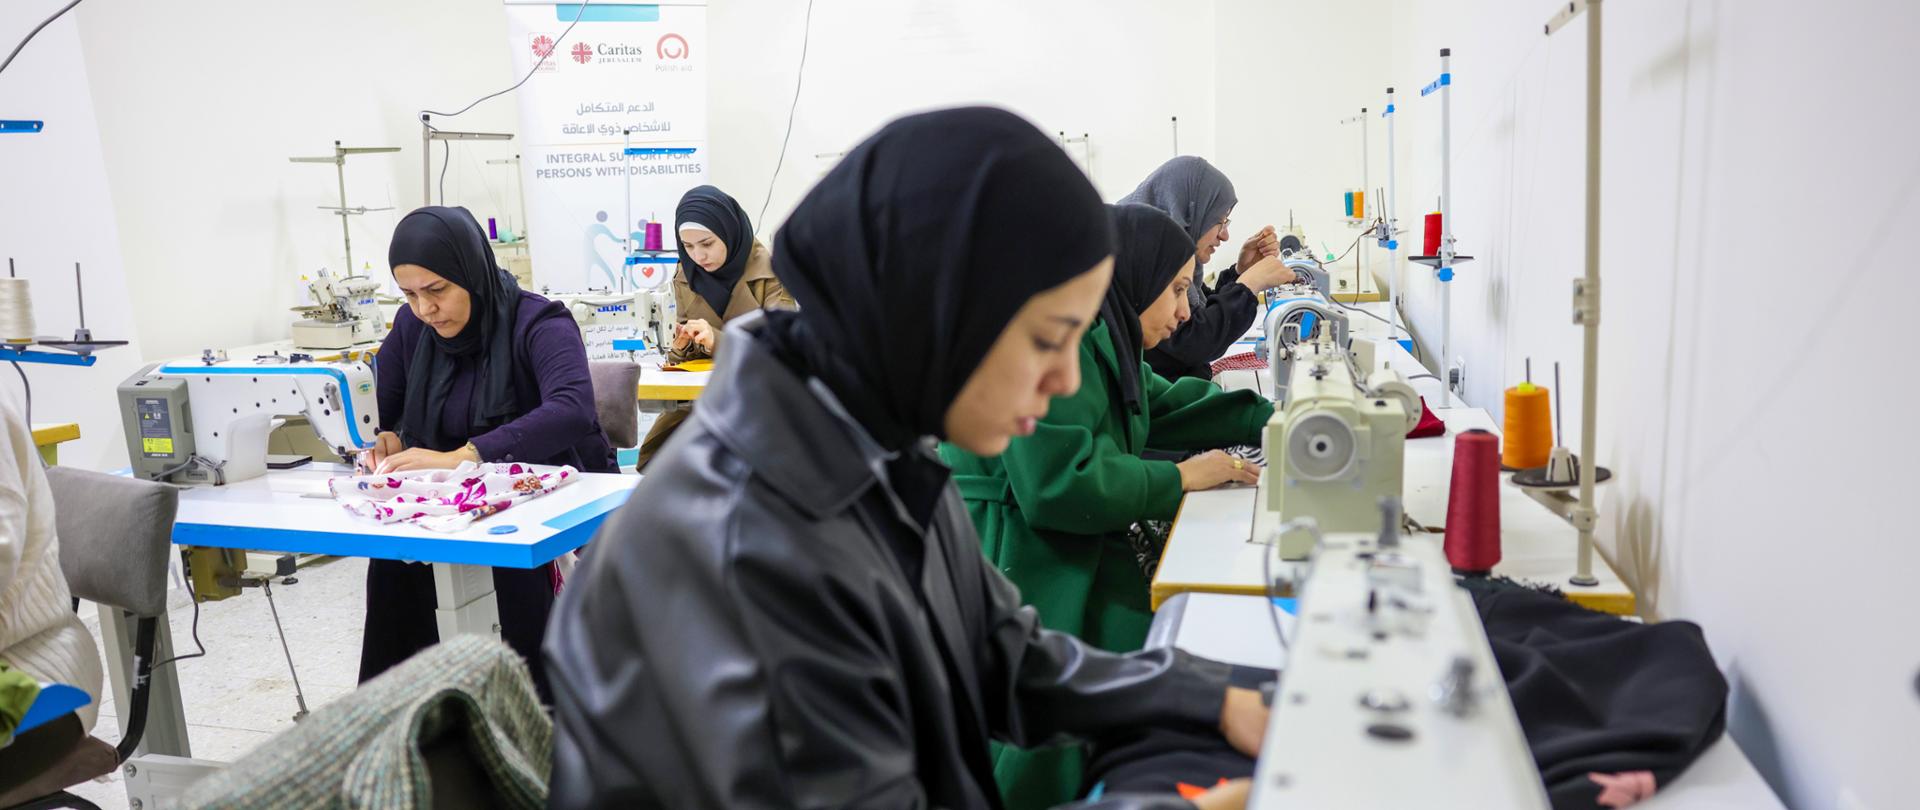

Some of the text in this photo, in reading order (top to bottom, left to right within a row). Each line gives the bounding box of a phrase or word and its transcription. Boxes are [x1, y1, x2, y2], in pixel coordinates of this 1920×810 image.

[597, 43, 642, 56] Caritas
[576, 102, 655, 115] الدعم المتكامل
[598, 122, 621, 135] ذوي
[546, 153, 606, 164] INTEGRAL
[609, 150, 661, 162] SUPORT
[536, 163, 701, 179] PERSONS WITH DISABILITIES
[597, 304, 627, 313] JUKI
